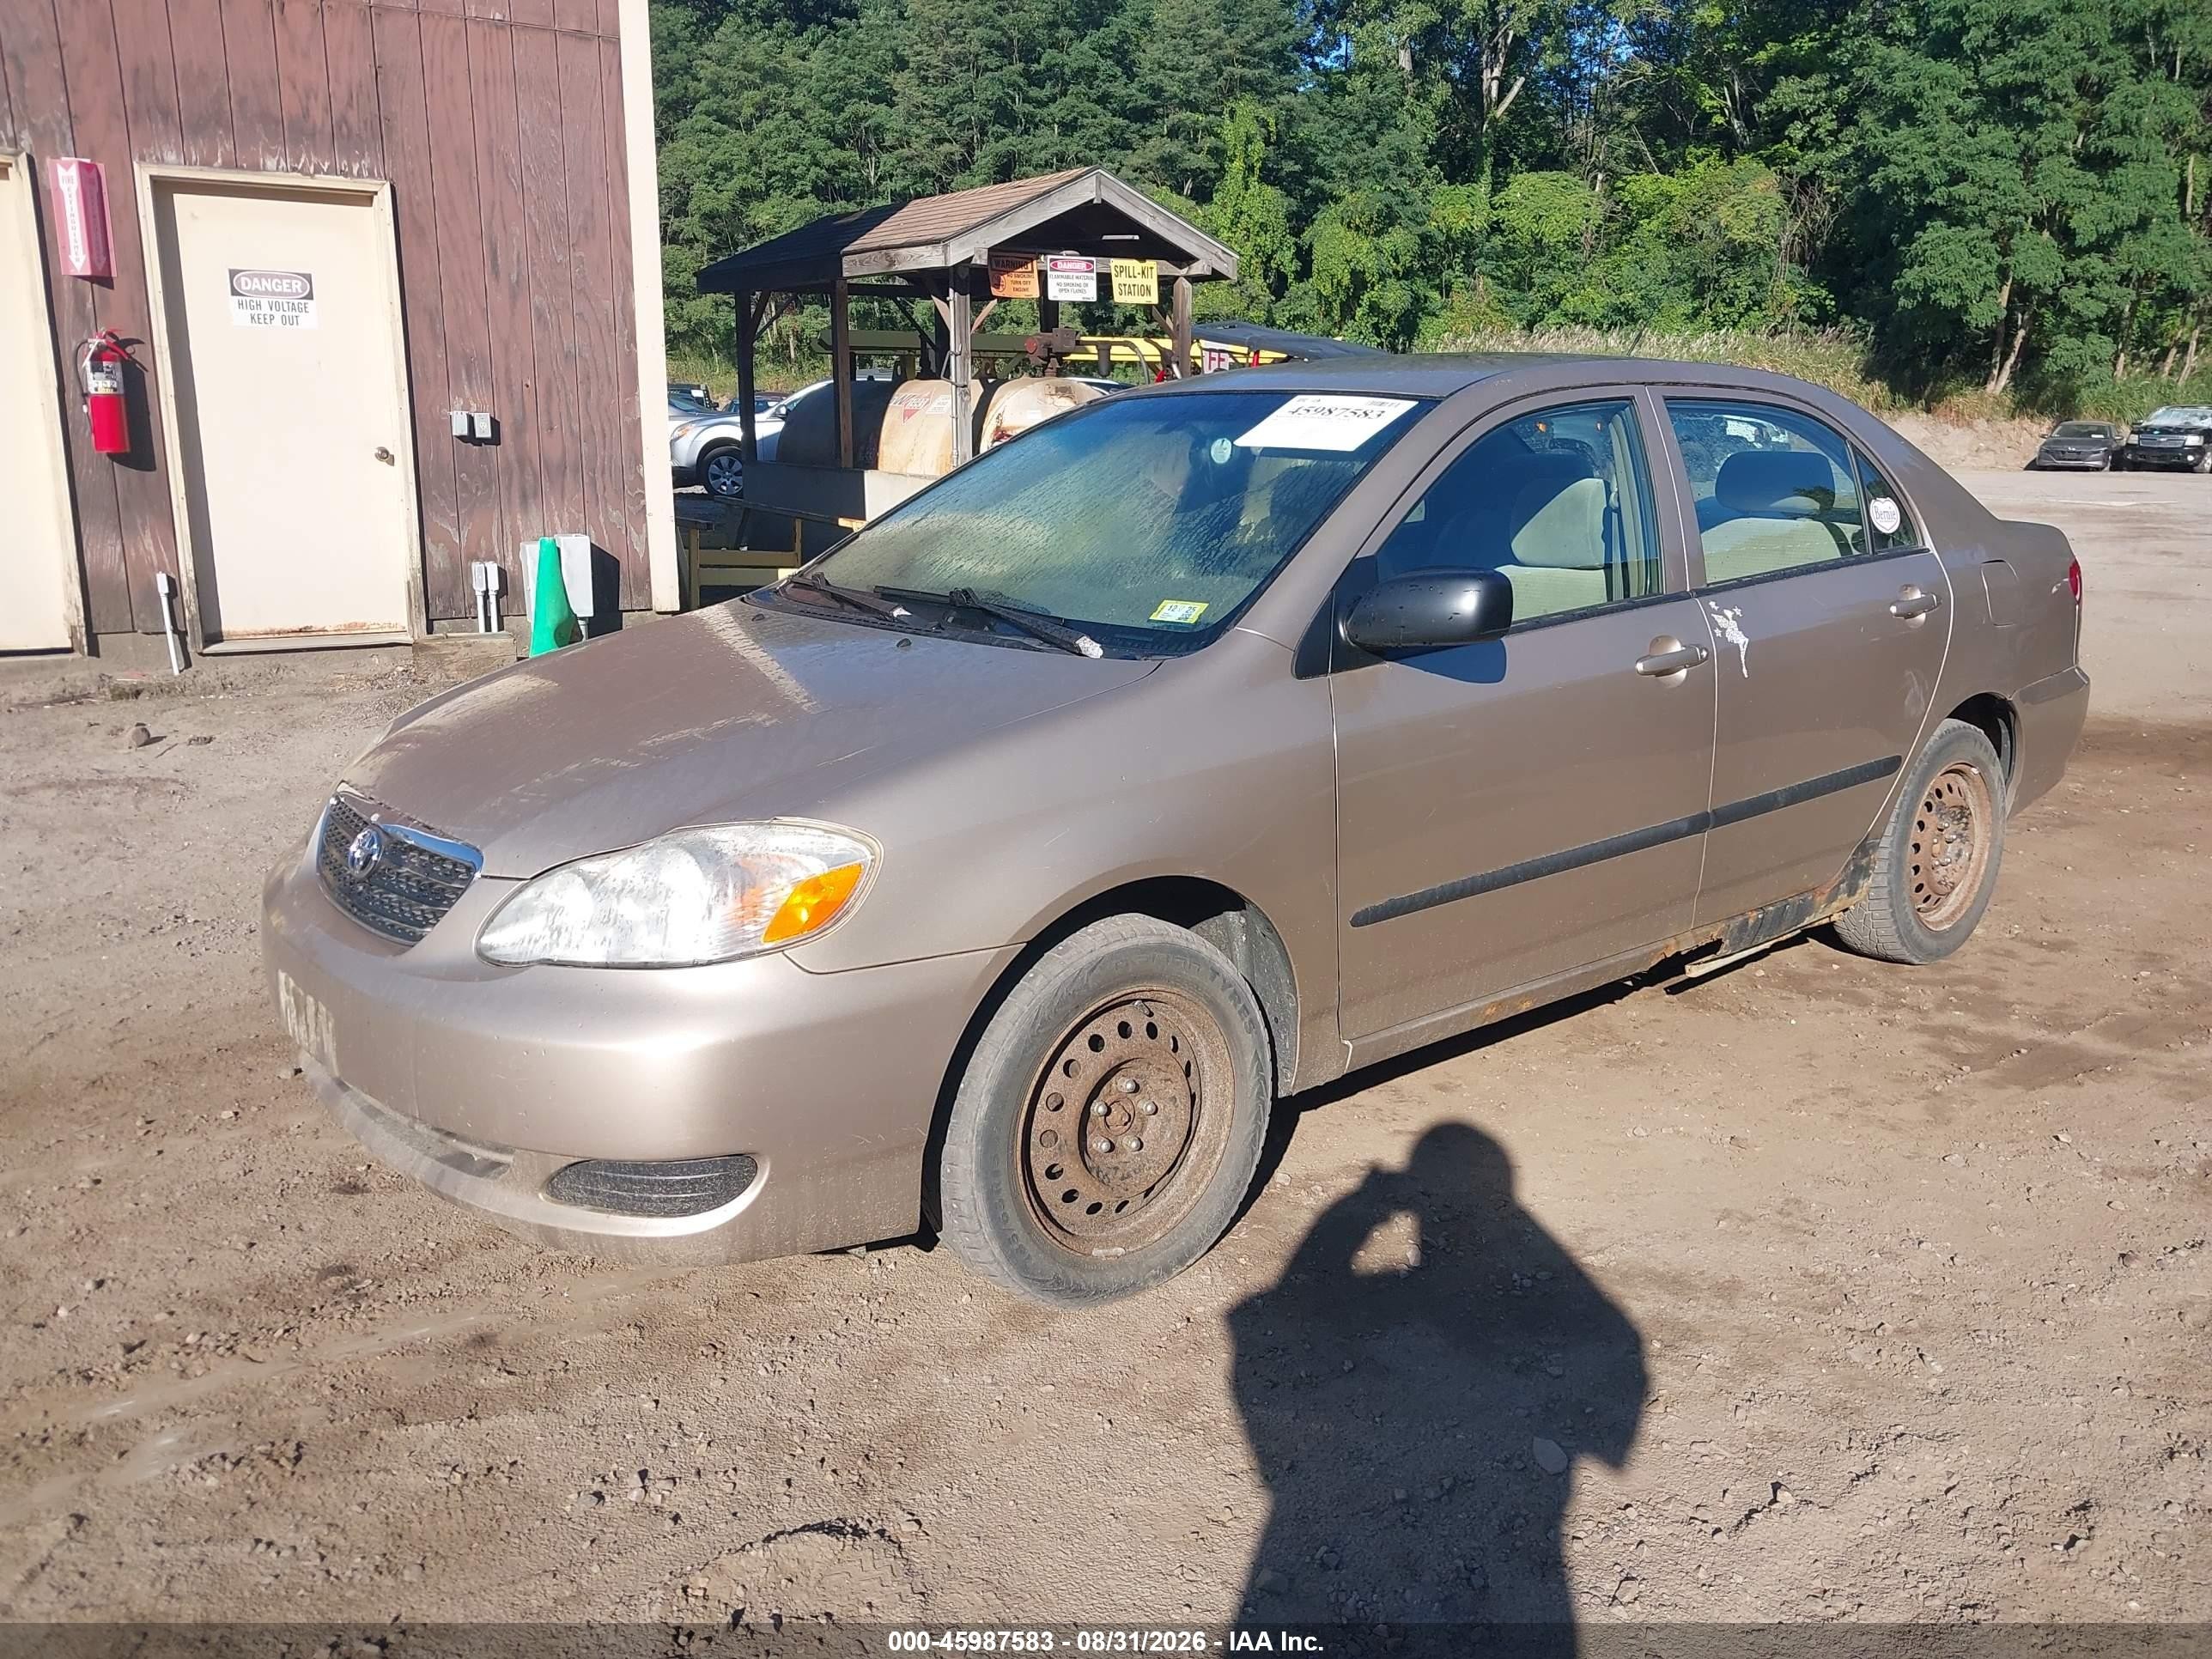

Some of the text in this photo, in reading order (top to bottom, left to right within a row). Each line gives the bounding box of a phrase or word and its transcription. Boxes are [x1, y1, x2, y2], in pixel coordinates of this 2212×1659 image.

[994, 258, 1029, 270] WARNING
[1057, 260, 1086, 270] DANGER
[1114, 264, 1154, 279] SPILL-KIT
[240, 276, 303, 293] DANGER
[1118, 283, 1152, 297] STATION
[237, 299, 310, 313] HIGH VOLTAGE
[250, 313, 300, 325] KEEP OUT
[1287, 405, 1386, 420] 45987583
[1874, 505, 1897, 520] Bernie
